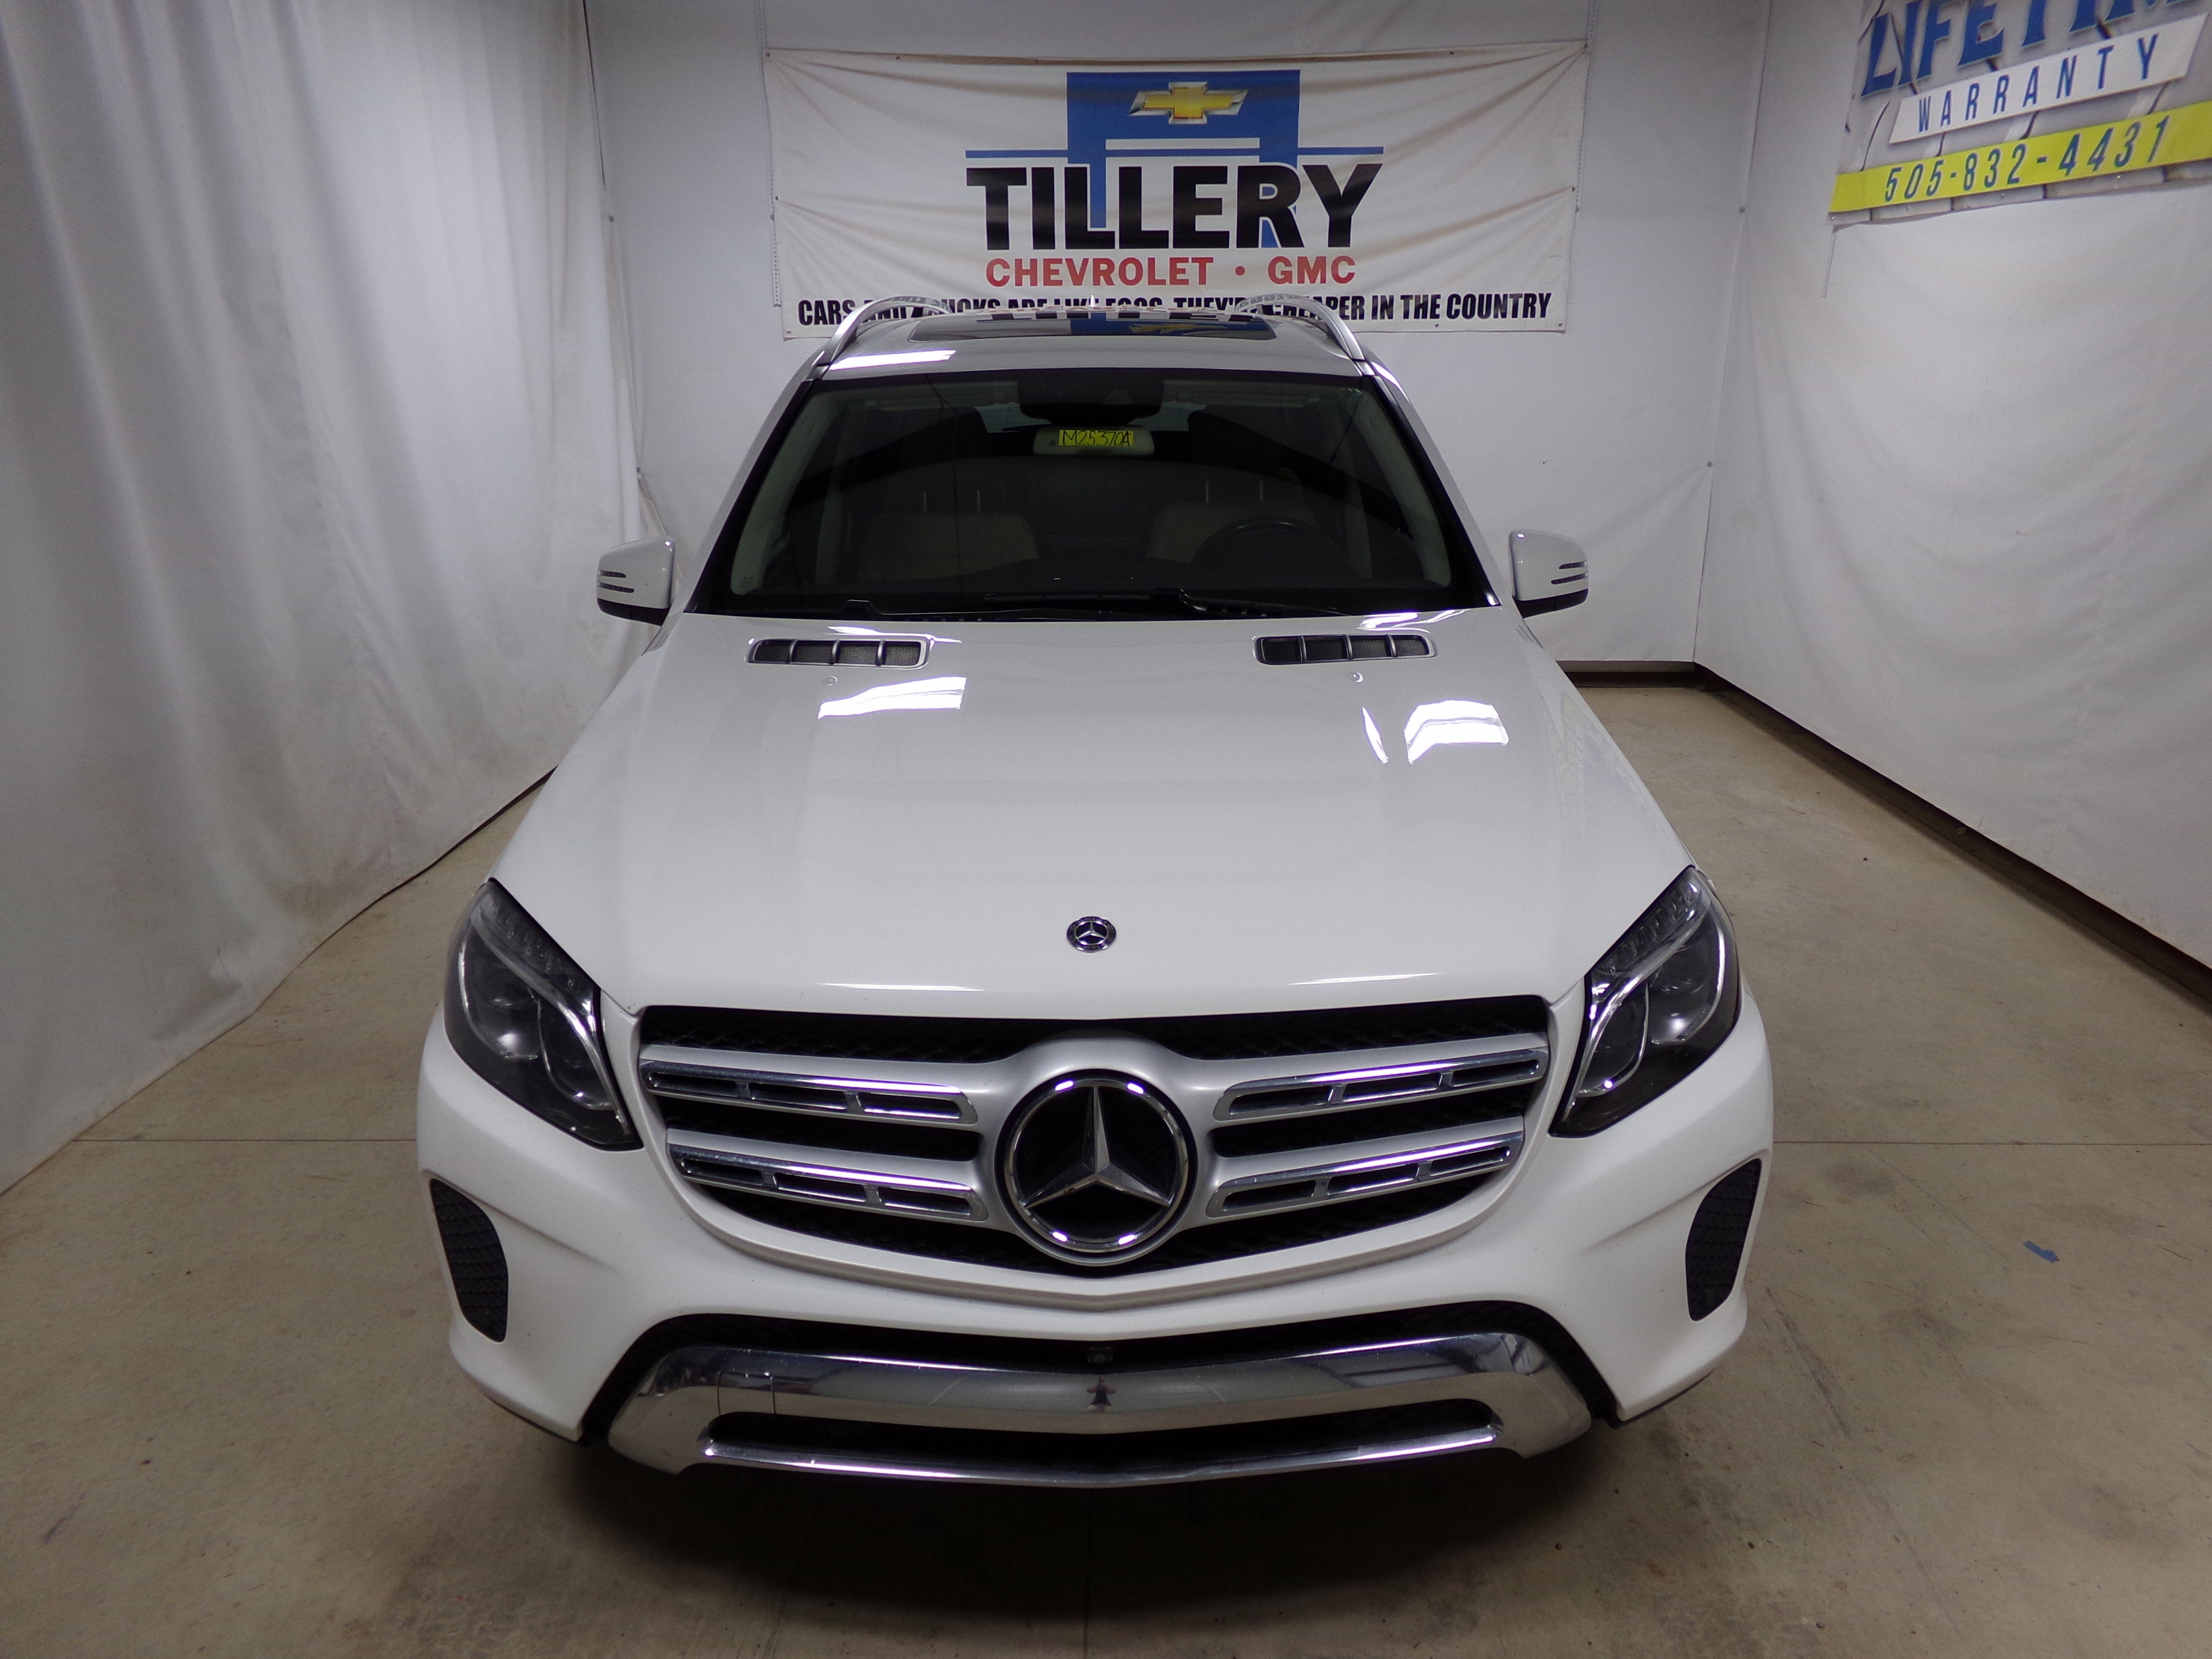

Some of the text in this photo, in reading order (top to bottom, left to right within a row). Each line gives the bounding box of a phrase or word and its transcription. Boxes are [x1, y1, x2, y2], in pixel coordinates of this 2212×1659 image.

[1861, 0, 2202, 96] LIFET
[1919, 33, 2158, 132] WARRANTY
[1884, 115, 2169, 202] 505-832-4431
[966, 163, 1383, 251] TILLERY
[798, 299, 856, 325] CARS
[1371, 295, 1394, 320] IN
[1400, 294, 1441, 320] THE
[1446, 292, 1552, 320] COUNTRY
[986, 255, 1356, 287] CHEVROLET GMC
